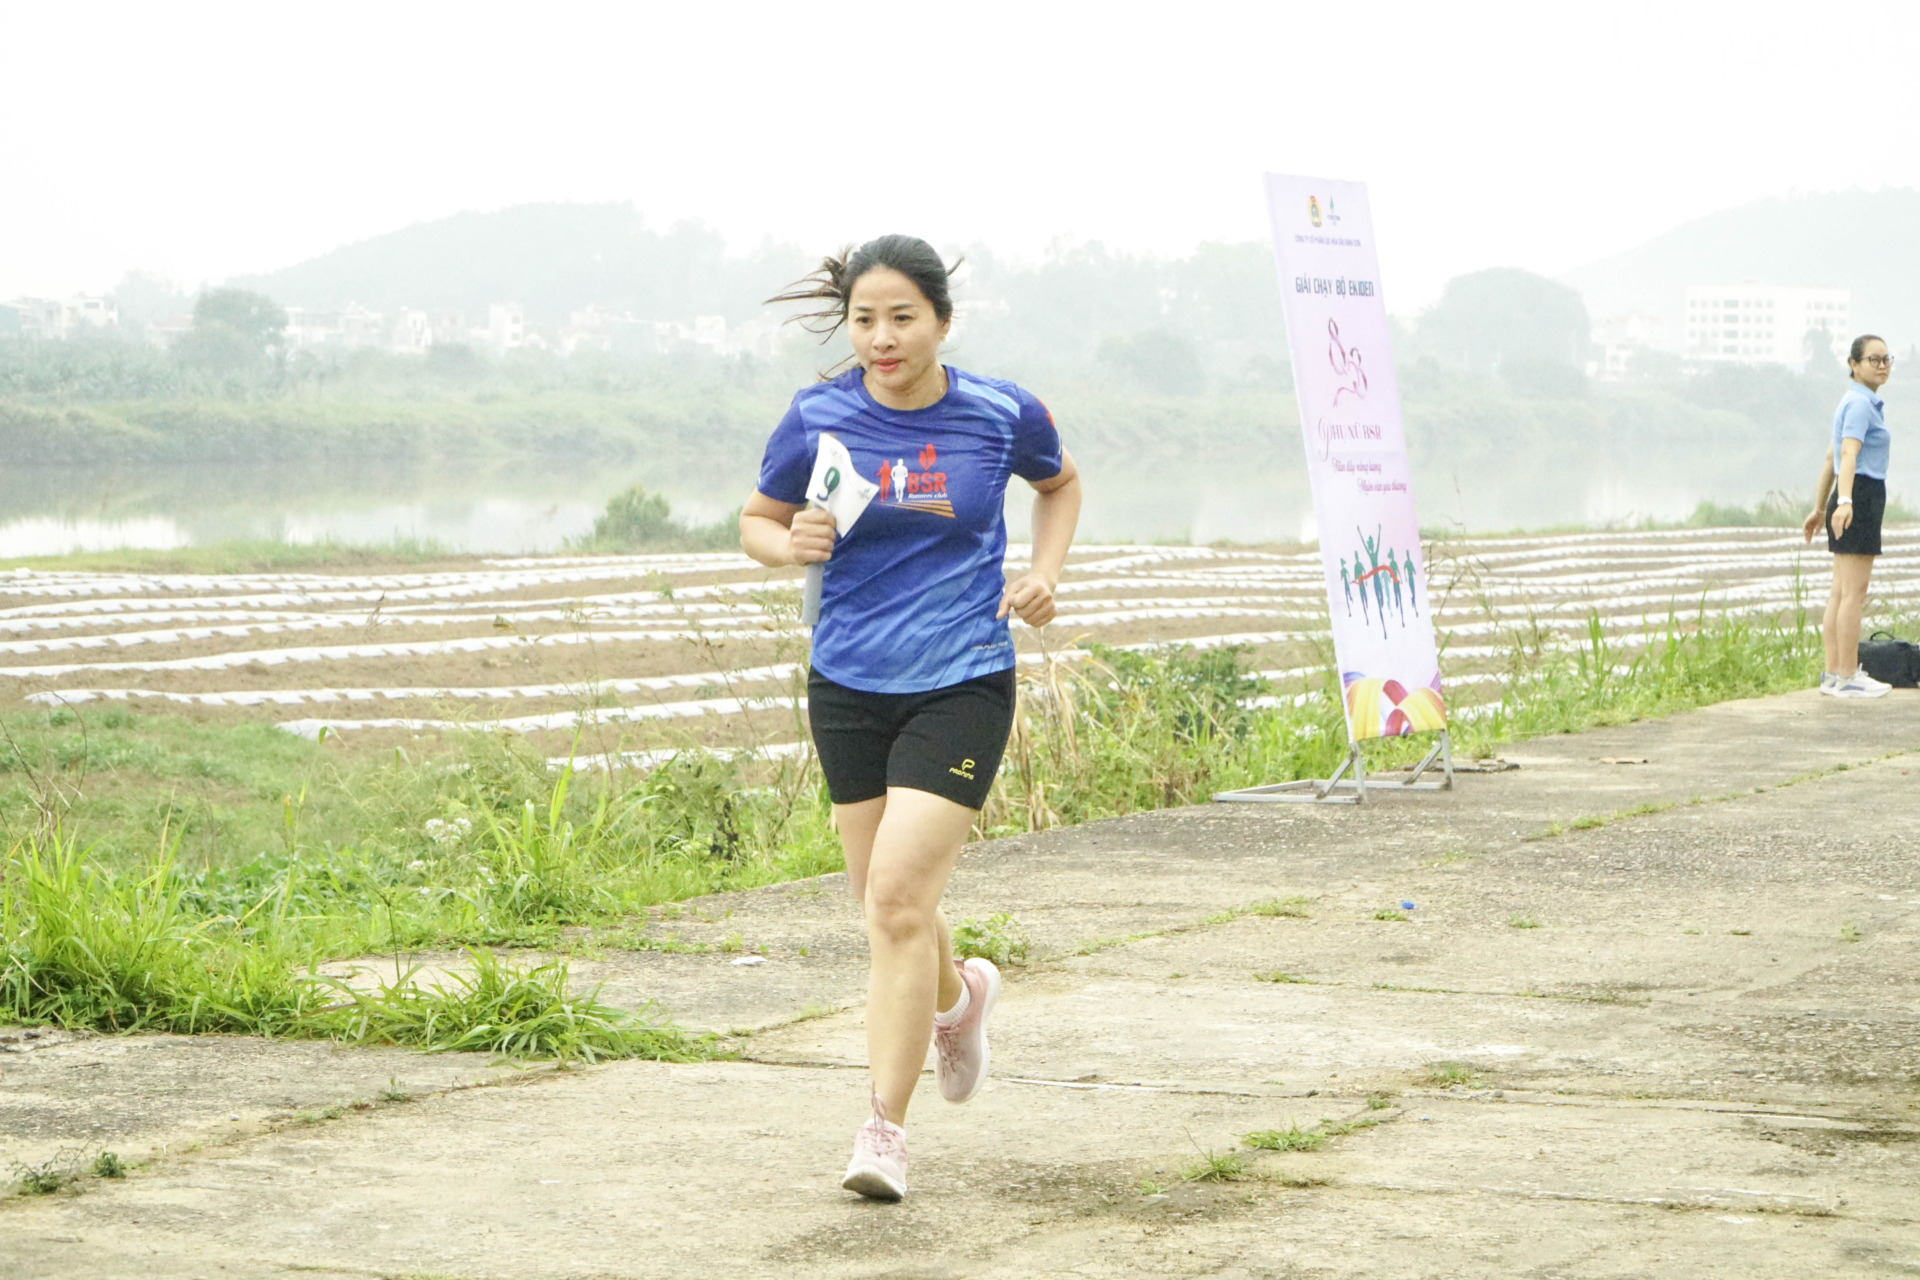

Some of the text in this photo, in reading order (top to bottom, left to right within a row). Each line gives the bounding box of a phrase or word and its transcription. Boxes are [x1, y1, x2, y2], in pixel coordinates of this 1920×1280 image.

[1313, 278, 1333, 298] CHẠY
[1336, 275, 1346, 299] BỘ
[1348, 280, 1374, 297] EKIDEN
[1363, 424, 1382, 440] BSR
[907, 472, 947, 493] BSR
[934, 491, 948, 499] club
